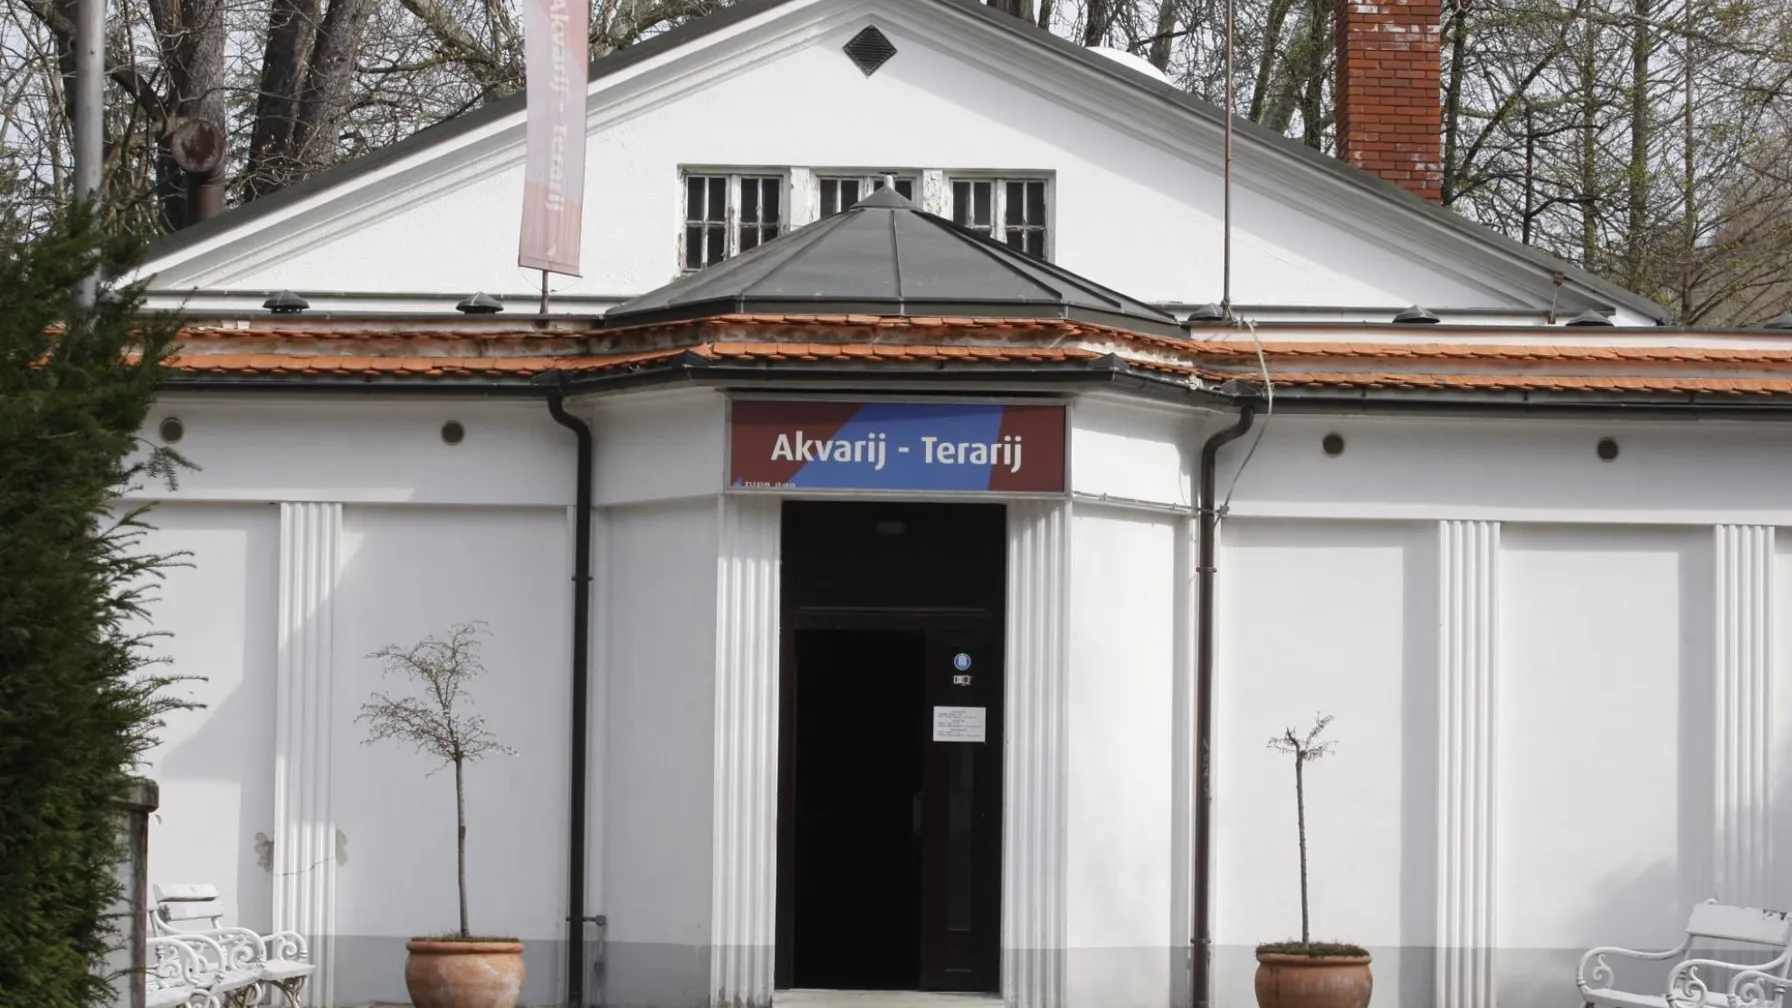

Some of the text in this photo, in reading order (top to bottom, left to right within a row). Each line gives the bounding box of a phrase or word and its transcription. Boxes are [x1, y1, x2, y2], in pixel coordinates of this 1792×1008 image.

[544, 124, 568, 211] Terarij
[770, 430, 886, 471] Akvarij
[921, 435, 1022, 473] Terarij
